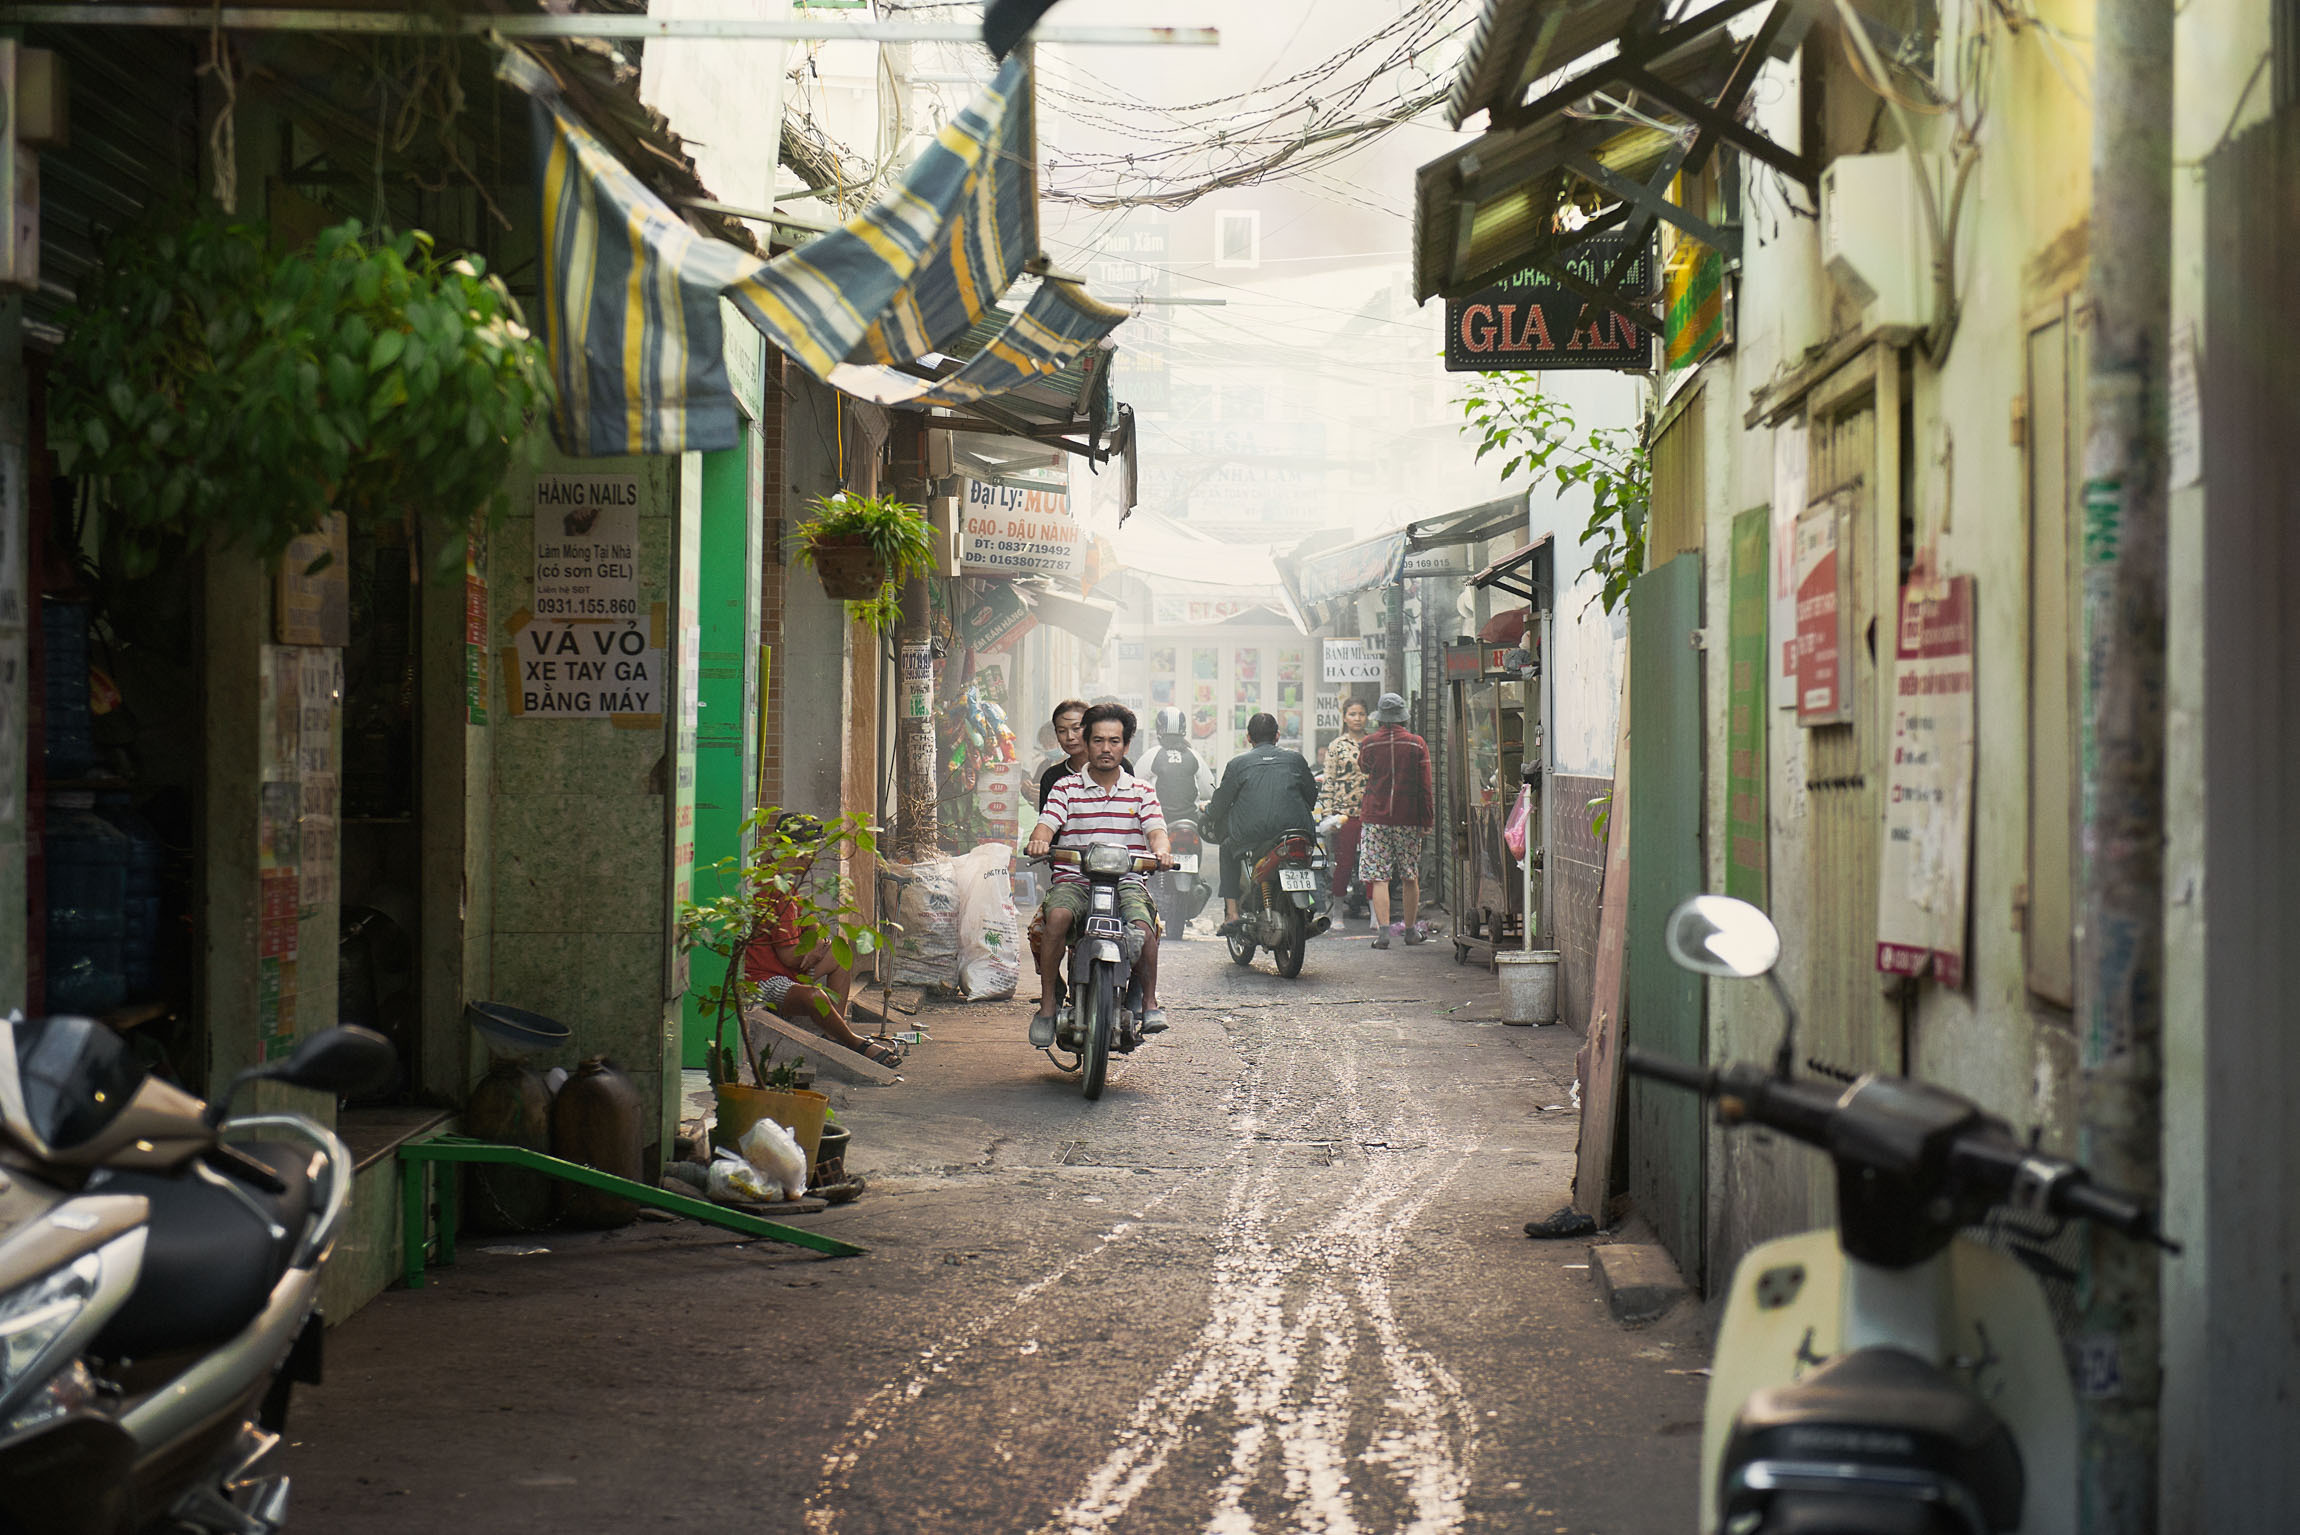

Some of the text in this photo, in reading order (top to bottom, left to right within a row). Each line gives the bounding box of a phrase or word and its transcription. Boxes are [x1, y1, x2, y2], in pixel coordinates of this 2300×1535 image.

[1461, 303, 1555, 352] GIA
[590, 483, 636, 505] NAILS
[970, 480, 995, 509] Đại
[968, 518, 997, 538] GẠO
[1007, 519, 1037, 541] ĐẬU
[1040, 521, 1079, 544] NÀNH
[538, 544, 631, 562] Làm Móng Tại Nhà
[975, 538, 994, 550] ĐT:
[537, 563, 633, 582] (có sơn GEL)
[1416, 560, 1432, 568] 169
[538, 598, 636, 614] 0931.155.860
[531, 620, 645, 656] VÁ VỎ
[526, 661, 648, 681] XE TAY GA
[525, 684, 649, 712] BẰNG MÁY
[1286, 881, 1311, 889] 5018
